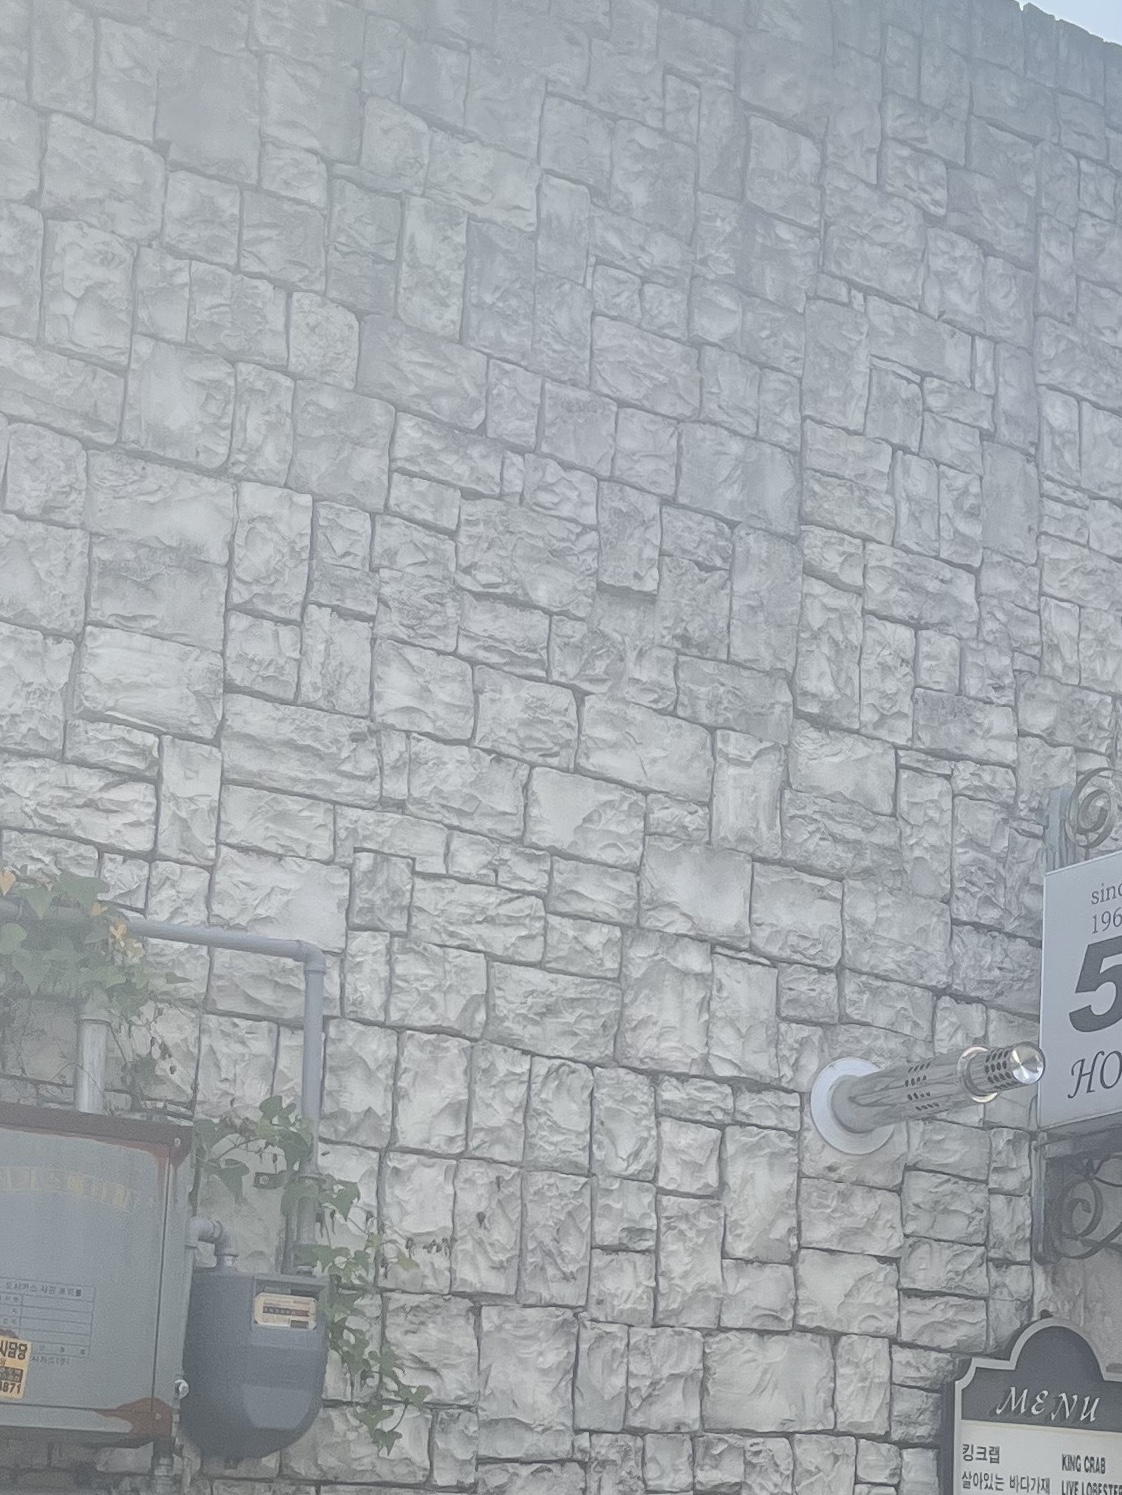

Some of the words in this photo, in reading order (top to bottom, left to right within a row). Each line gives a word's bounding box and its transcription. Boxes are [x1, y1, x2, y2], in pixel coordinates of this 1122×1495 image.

[996, 1386, 1100, 1422] MENU
[962, 1444, 1000, 1464] 킹크랩
[1062, 1454, 1081, 1472] KING
[1084, 1455, 1106, 1474] CRAB
[961, 1471, 1005, 1491] 살아있는
[1009, 1474, 1051, 1495] 바다가재
